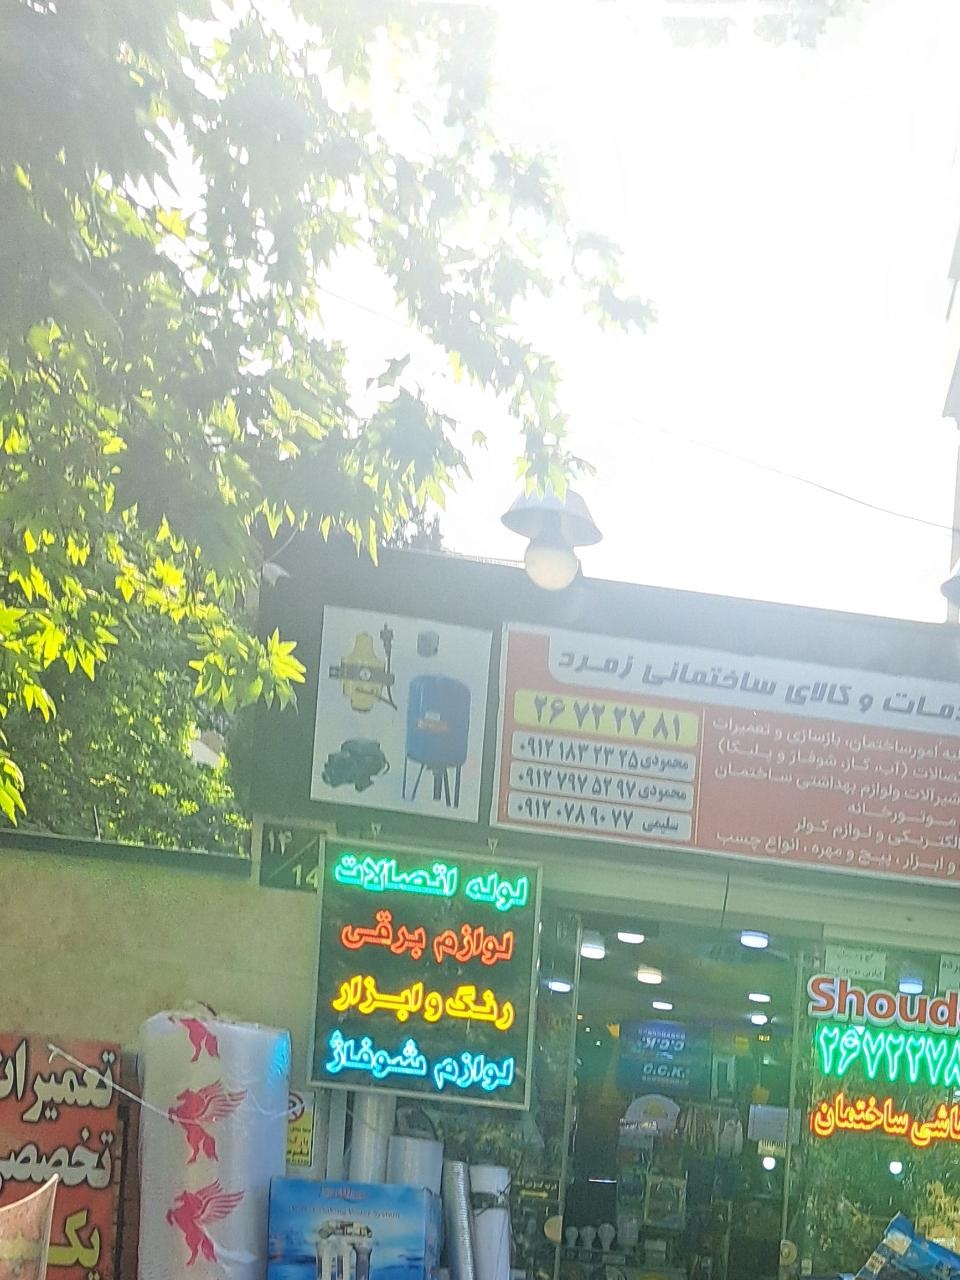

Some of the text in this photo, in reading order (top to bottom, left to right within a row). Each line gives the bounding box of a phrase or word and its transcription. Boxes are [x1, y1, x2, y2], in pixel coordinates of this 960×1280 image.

[558, 651, 634, 679] زمرد
[641, 661, 777, 696] ساختمانی
[784, 680, 852, 706] کالای
[859, 693, 874, 713] و
[334, 854, 529, 912] لوله اتصالات
[341, 908, 515, 966] لوازم برقی
[331, 974, 516, 1032] رنگ و ابزار
[325, 1029, 515, 1092] لوازم شوفاژ
[813, 1093, 910, 1138] ساختمان
[0, 1127, 115, 1192] تخصص
